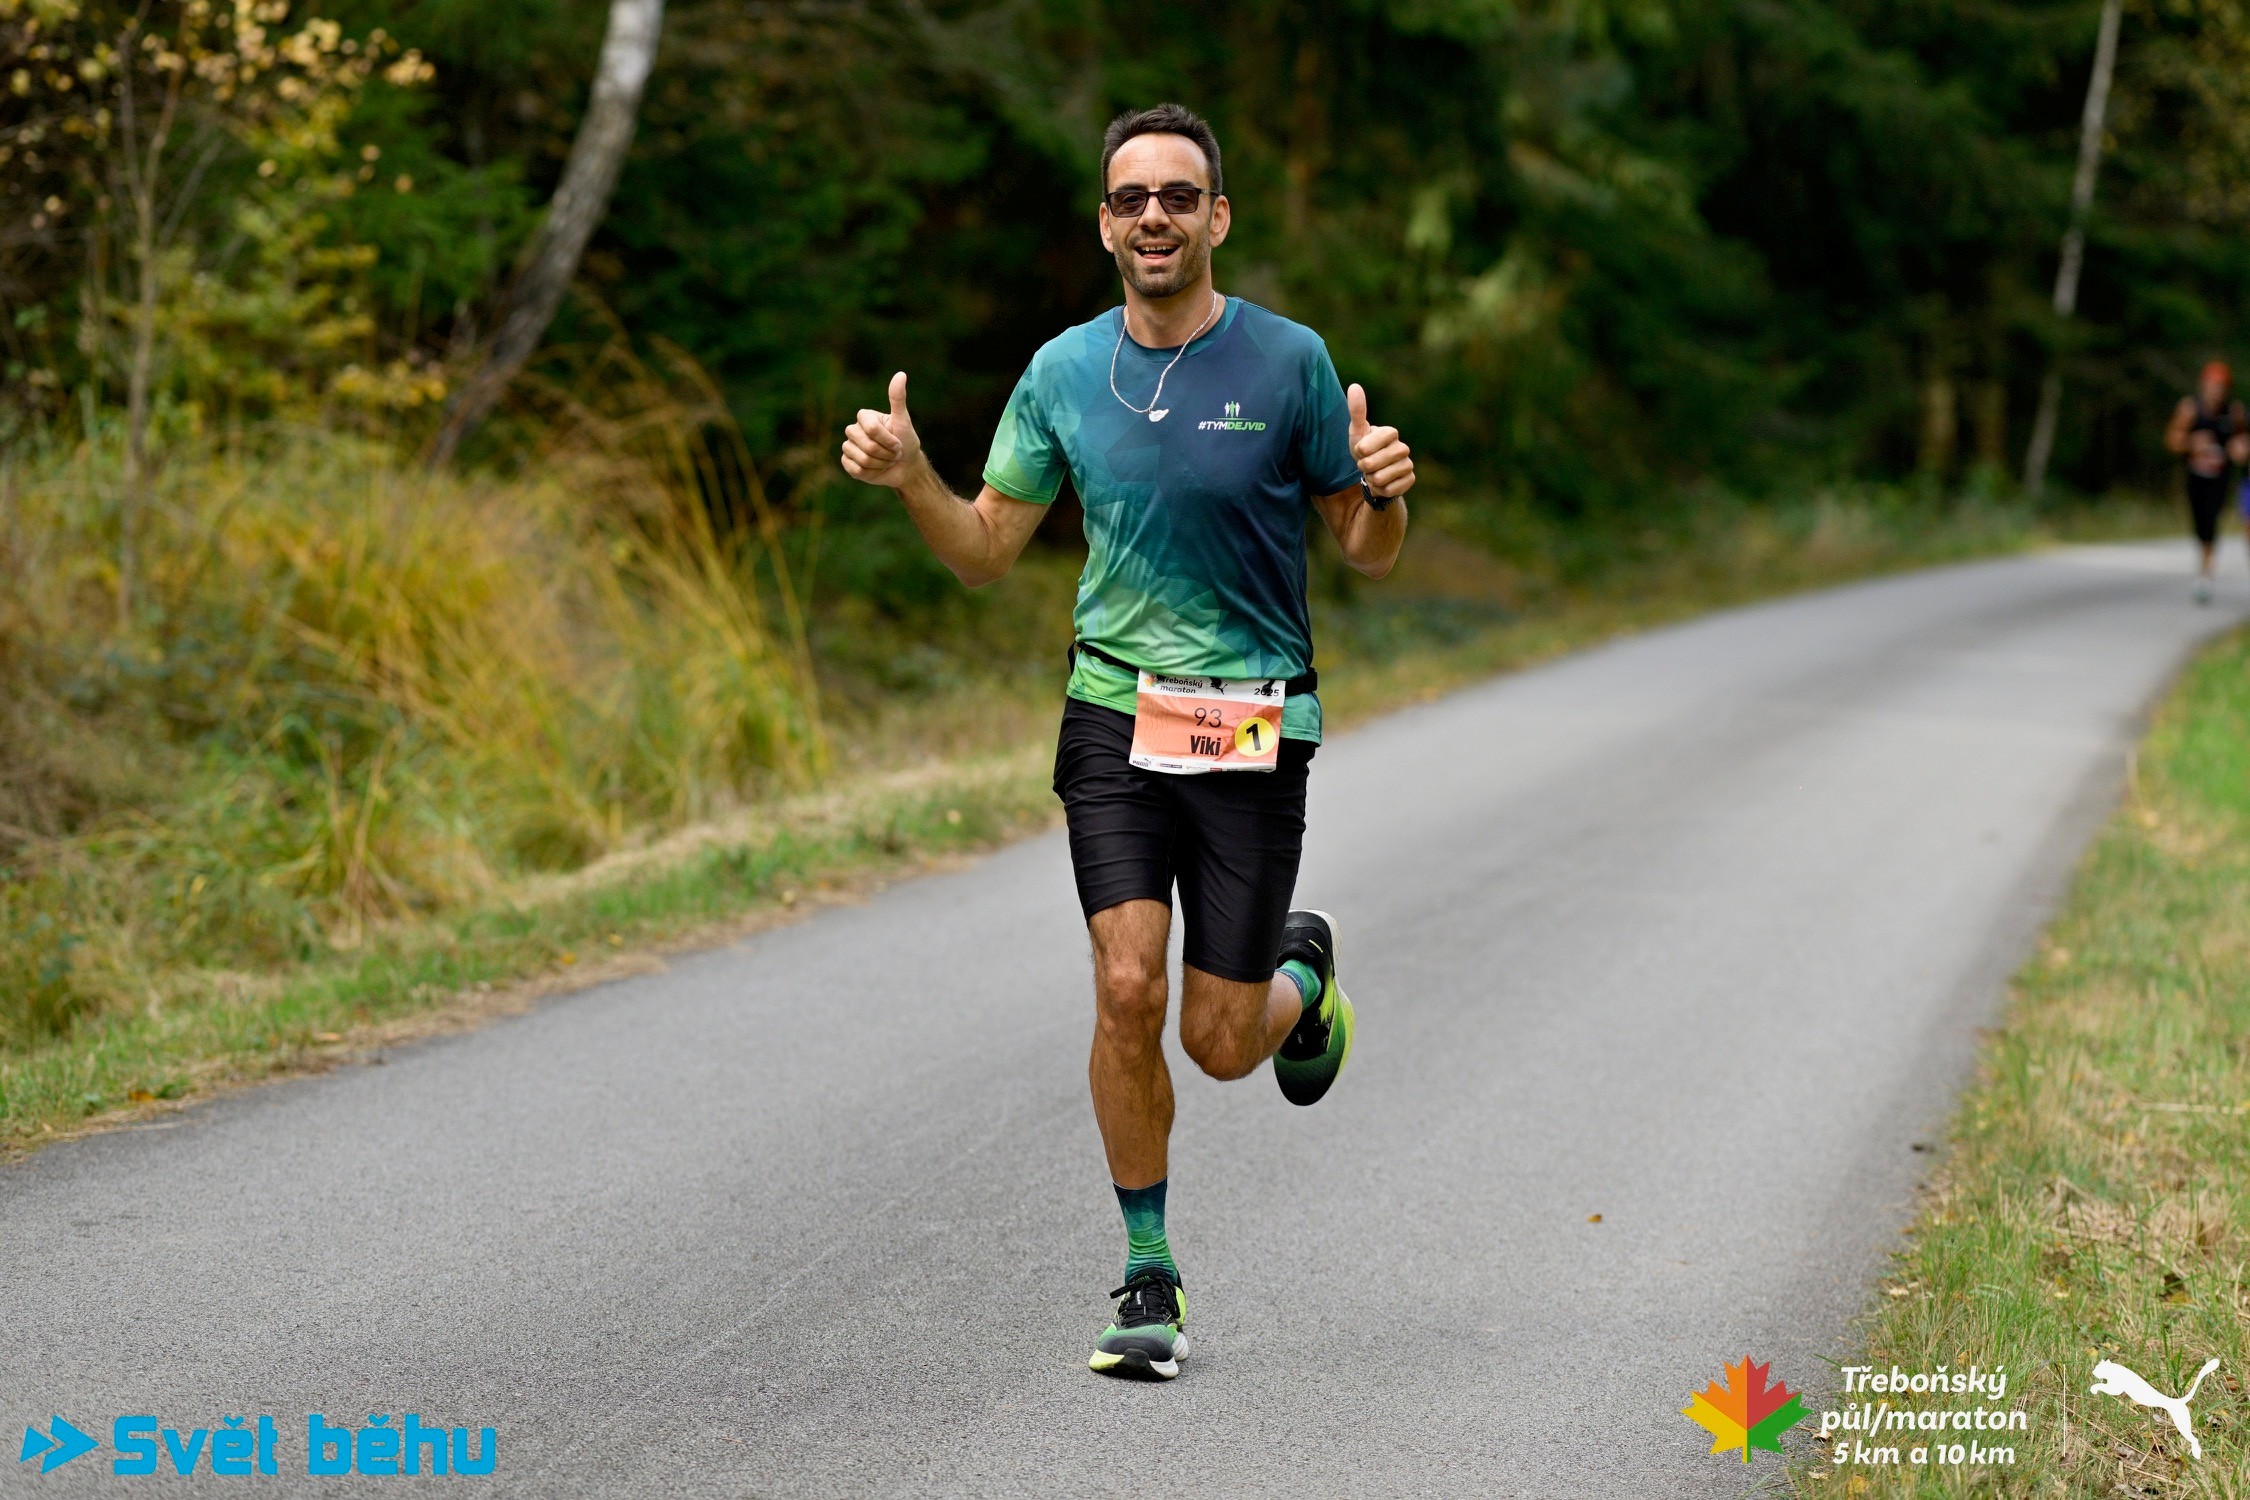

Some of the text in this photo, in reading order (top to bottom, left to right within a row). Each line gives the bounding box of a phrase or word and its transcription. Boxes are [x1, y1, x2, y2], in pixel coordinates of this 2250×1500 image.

[1198, 421, 1266, 430] #TYMDEJVID
[1160, 685, 1196, 694] maraton
[1194, 707, 1222, 728] 93
[1190, 735, 1222, 756] Viki
[1246, 723, 1261, 751] 1
